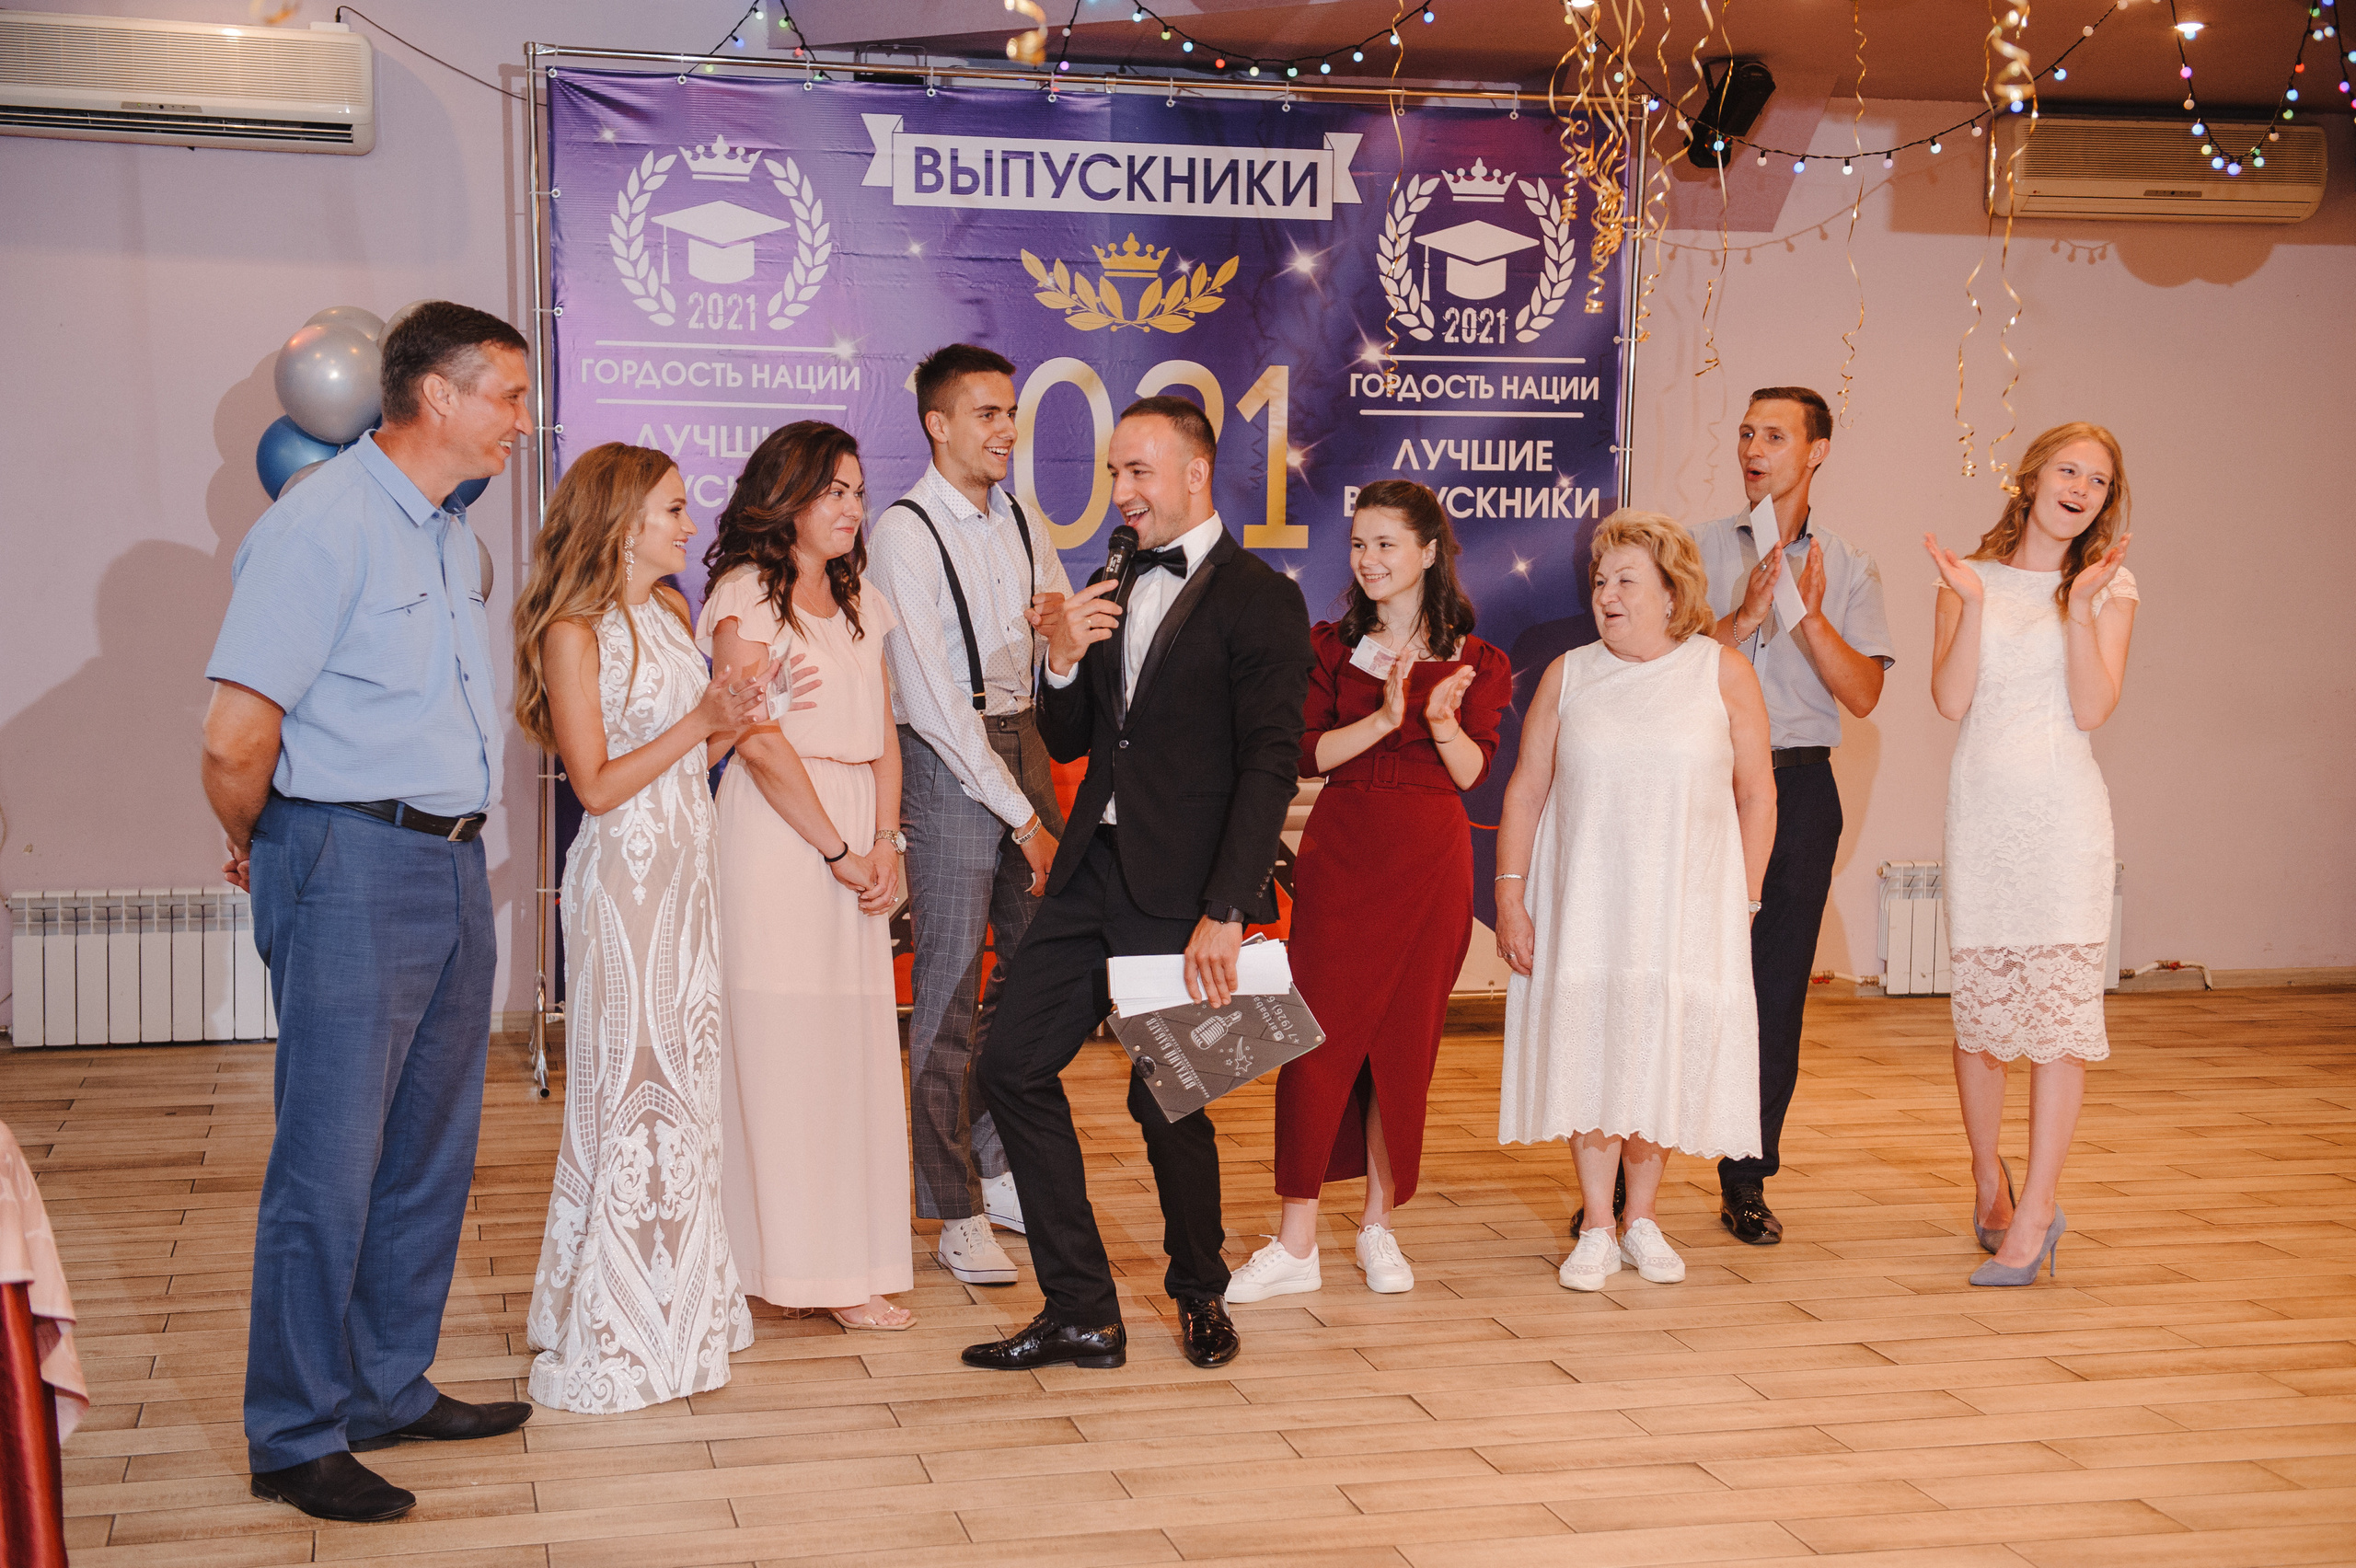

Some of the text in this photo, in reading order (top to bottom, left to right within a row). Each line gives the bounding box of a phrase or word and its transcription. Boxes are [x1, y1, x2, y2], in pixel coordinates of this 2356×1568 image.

[914, 145, 1319, 208] ВЫПУСКНИКИ
[687, 291, 758, 331] 2021
[1441, 306, 1507, 344] 2021
[581, 357, 860, 394] ГОРДОСТЬ НАЦИИ
[1349, 373, 1600, 405] ГОРДОСТЬ НАЦИИ
[1392, 438, 1553, 471] ЛУЧШИЕ
[1271, 1004, 1294, 1031] (926)
[1145, 1017, 1196, 1090] ВИТАЛИЙ БАБАЕВ
